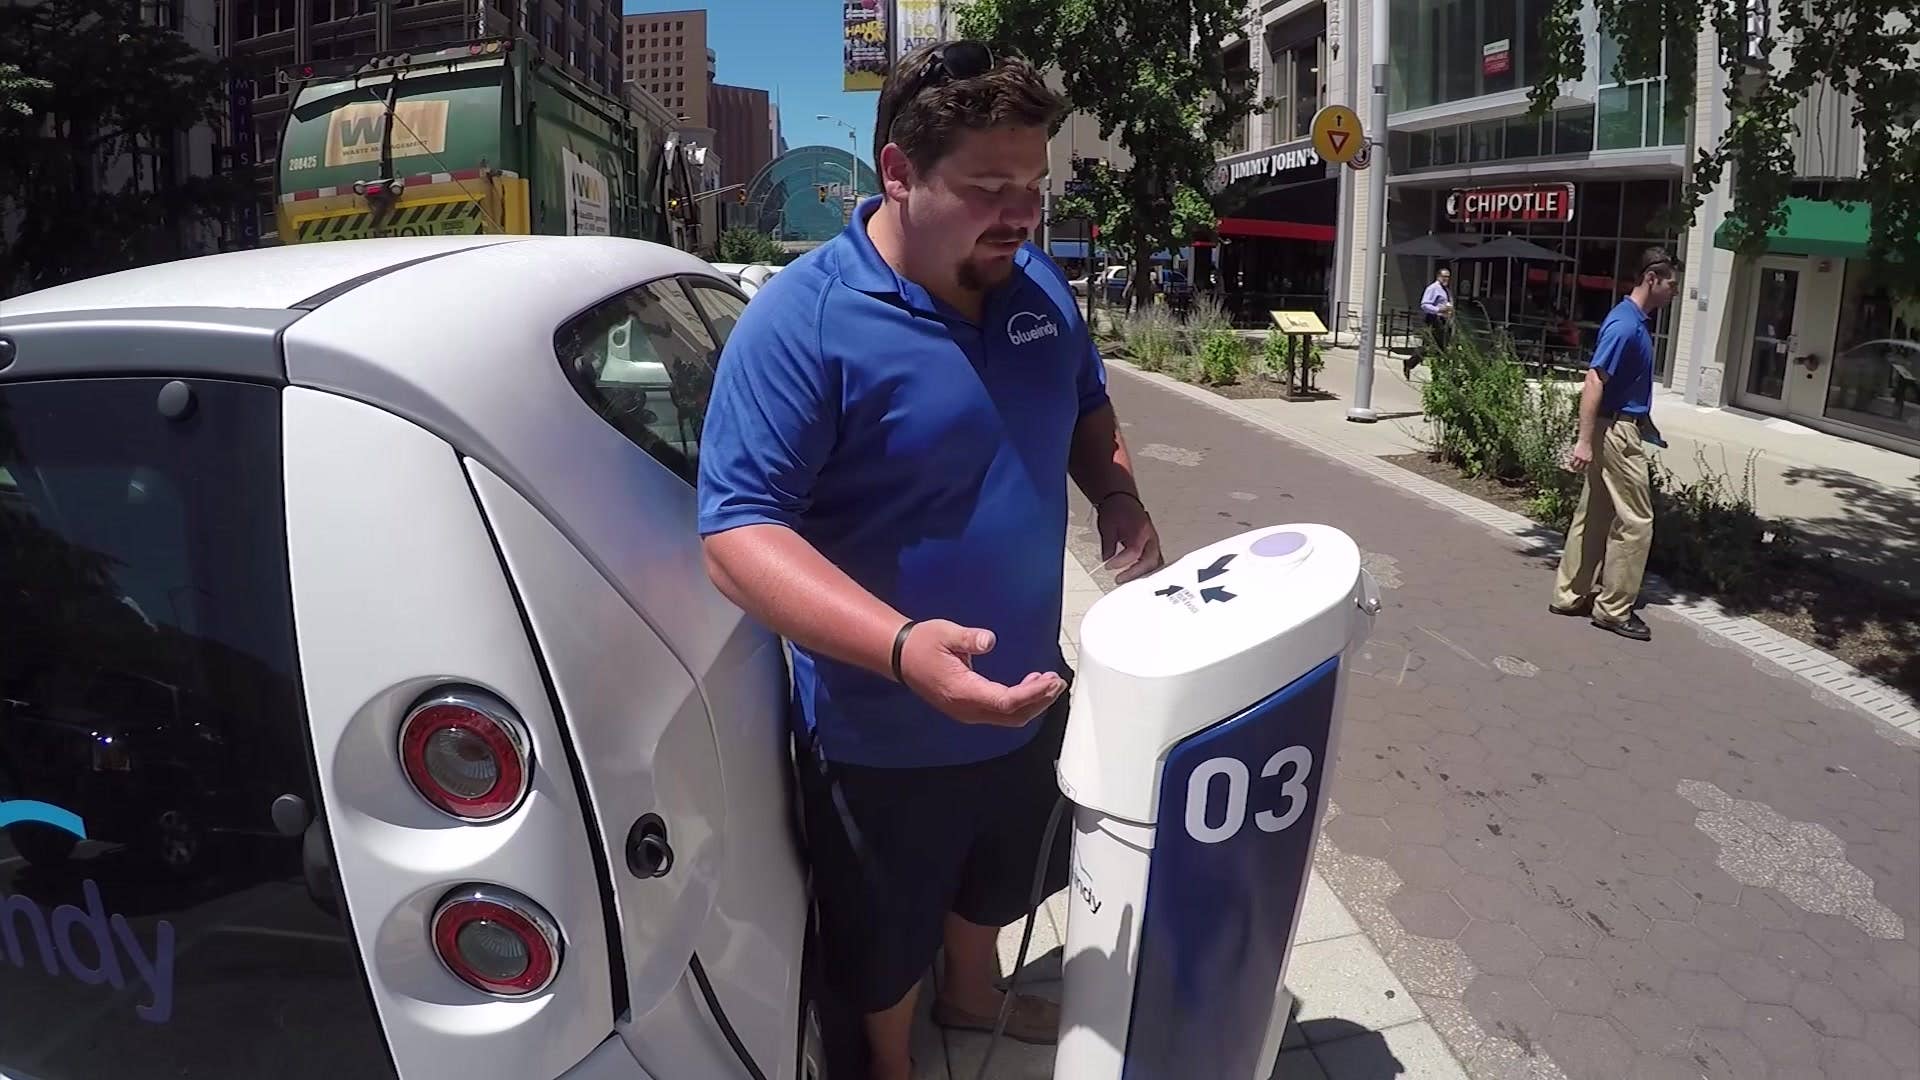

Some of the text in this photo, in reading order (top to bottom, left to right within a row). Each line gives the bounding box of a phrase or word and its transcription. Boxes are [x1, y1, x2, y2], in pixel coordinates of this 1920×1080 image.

[1230, 146, 1319, 184] JIMMY JOHN'S
[1465, 192, 1558, 213] CHIPOTLE
[1007, 320, 1059, 346] blueindy
[1184, 745, 1314, 844] 03
[0, 879, 175, 1024] ndy
